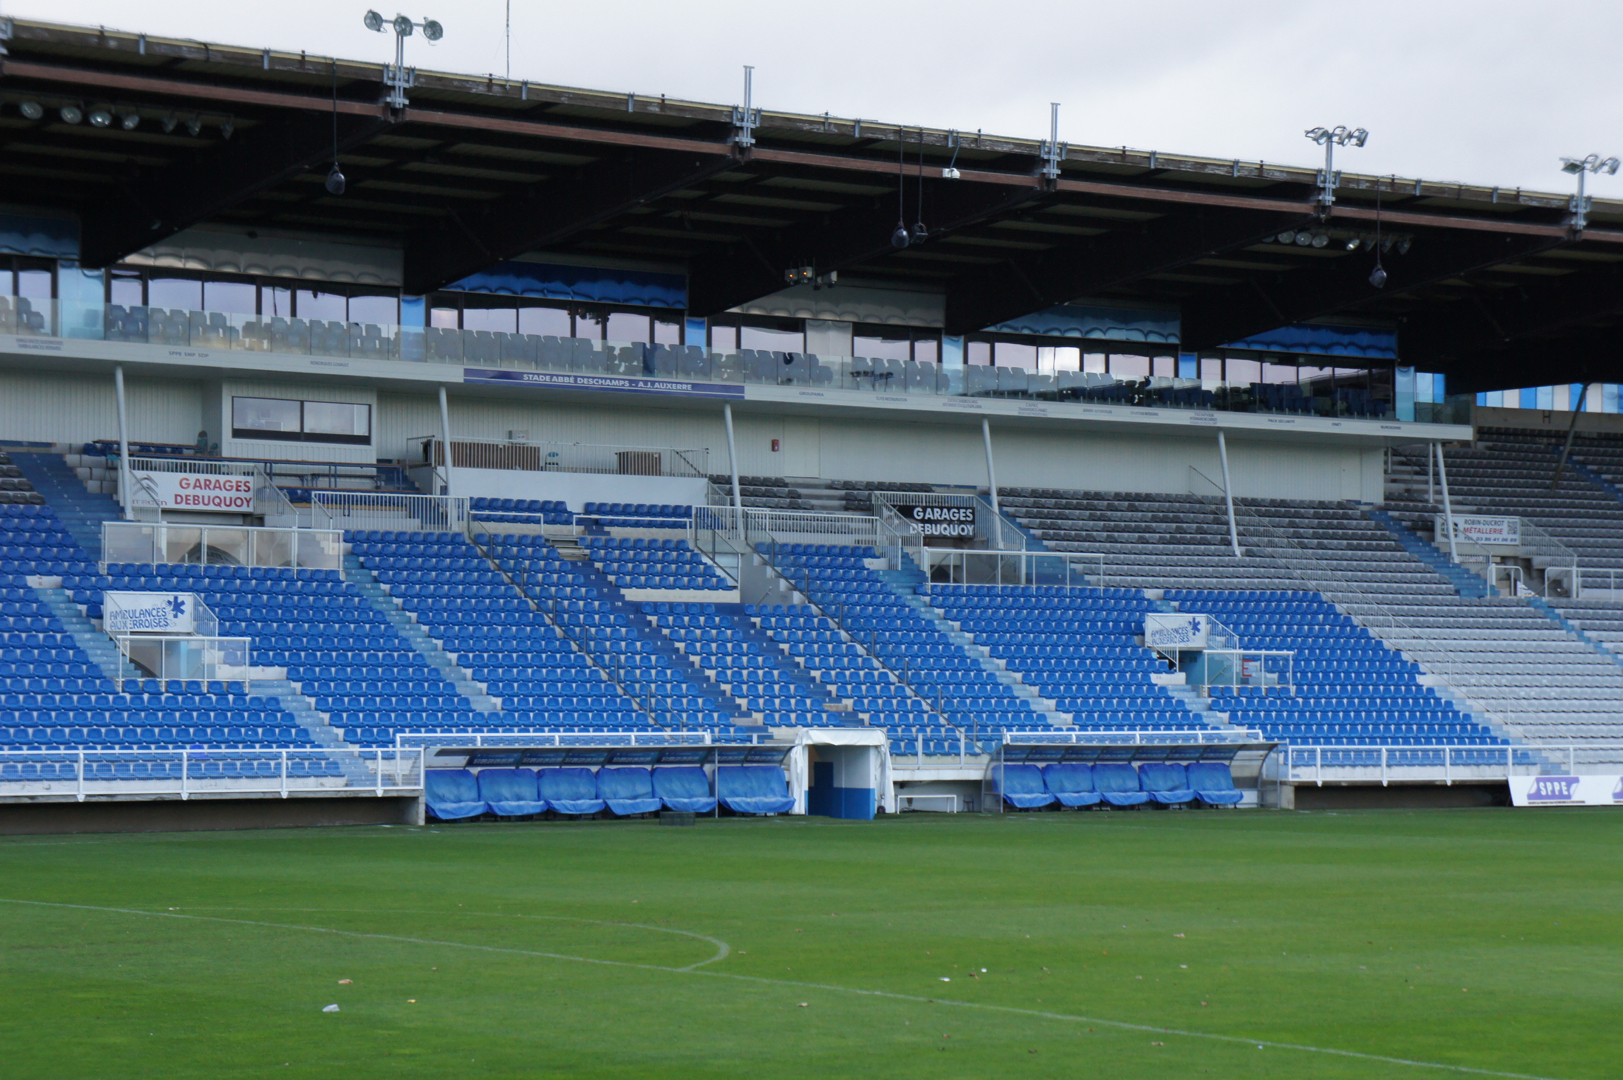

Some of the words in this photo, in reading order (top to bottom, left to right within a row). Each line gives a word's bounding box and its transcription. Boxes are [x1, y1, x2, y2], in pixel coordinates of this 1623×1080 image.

[523, 373, 550, 382] STADE
[552, 375, 575, 384] ABBÉ
[577, 377, 630, 387] DESCHAMPS
[653, 382, 693, 391] AUXERRE
[178, 477, 251, 493] GARAGES
[174, 493, 253, 508] DEBUQUOY
[913, 506, 974, 521] GARAGES
[909, 522, 975, 536] DEBUQUOY
[1464, 518, 1505, 527] ROBIN-DUCROT
[1463, 526, 1504, 535] MÉTALLERIE
[109, 607, 167, 621] AMBULANCES
[109, 617, 169, 630] AUXERROISES
[1150, 626, 1189, 639] AMBLANCES
[1241, 658, 1253, 677] E
[1539, 781, 1569, 796] SPPE
